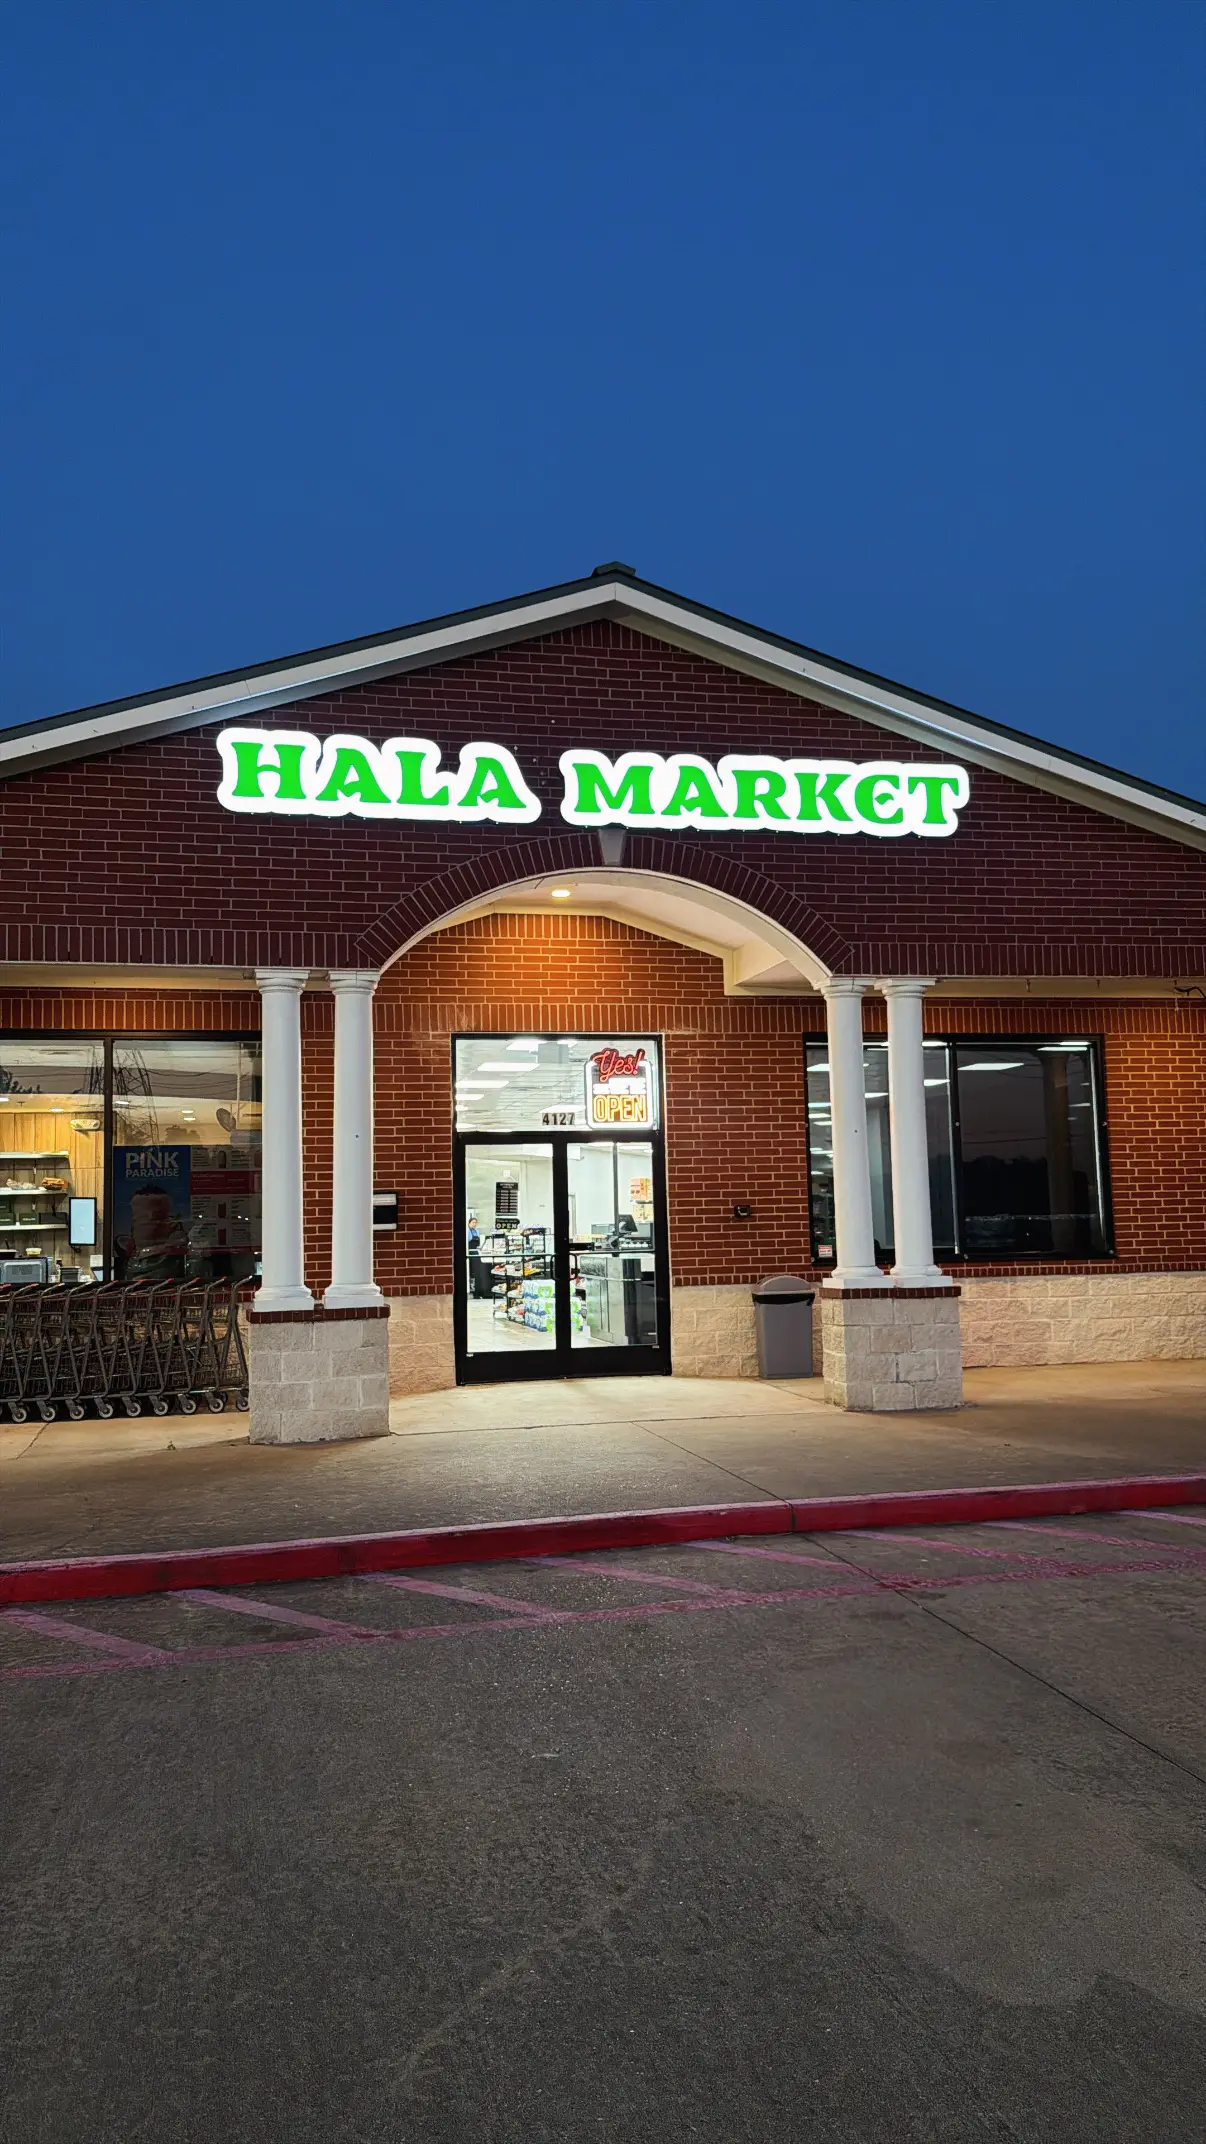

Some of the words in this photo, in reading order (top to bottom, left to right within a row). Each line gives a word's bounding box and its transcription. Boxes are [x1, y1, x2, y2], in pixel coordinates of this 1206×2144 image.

[230, 741, 528, 809] HALA
[571, 761, 960, 825] MARKET
[592, 1049, 644, 1082] Yes!
[543, 1112, 574, 1125] 4127
[593, 1094, 647, 1122] OPEN
[126, 1152, 179, 1169] PINK
[126, 1168, 180, 1178] PARADISE
